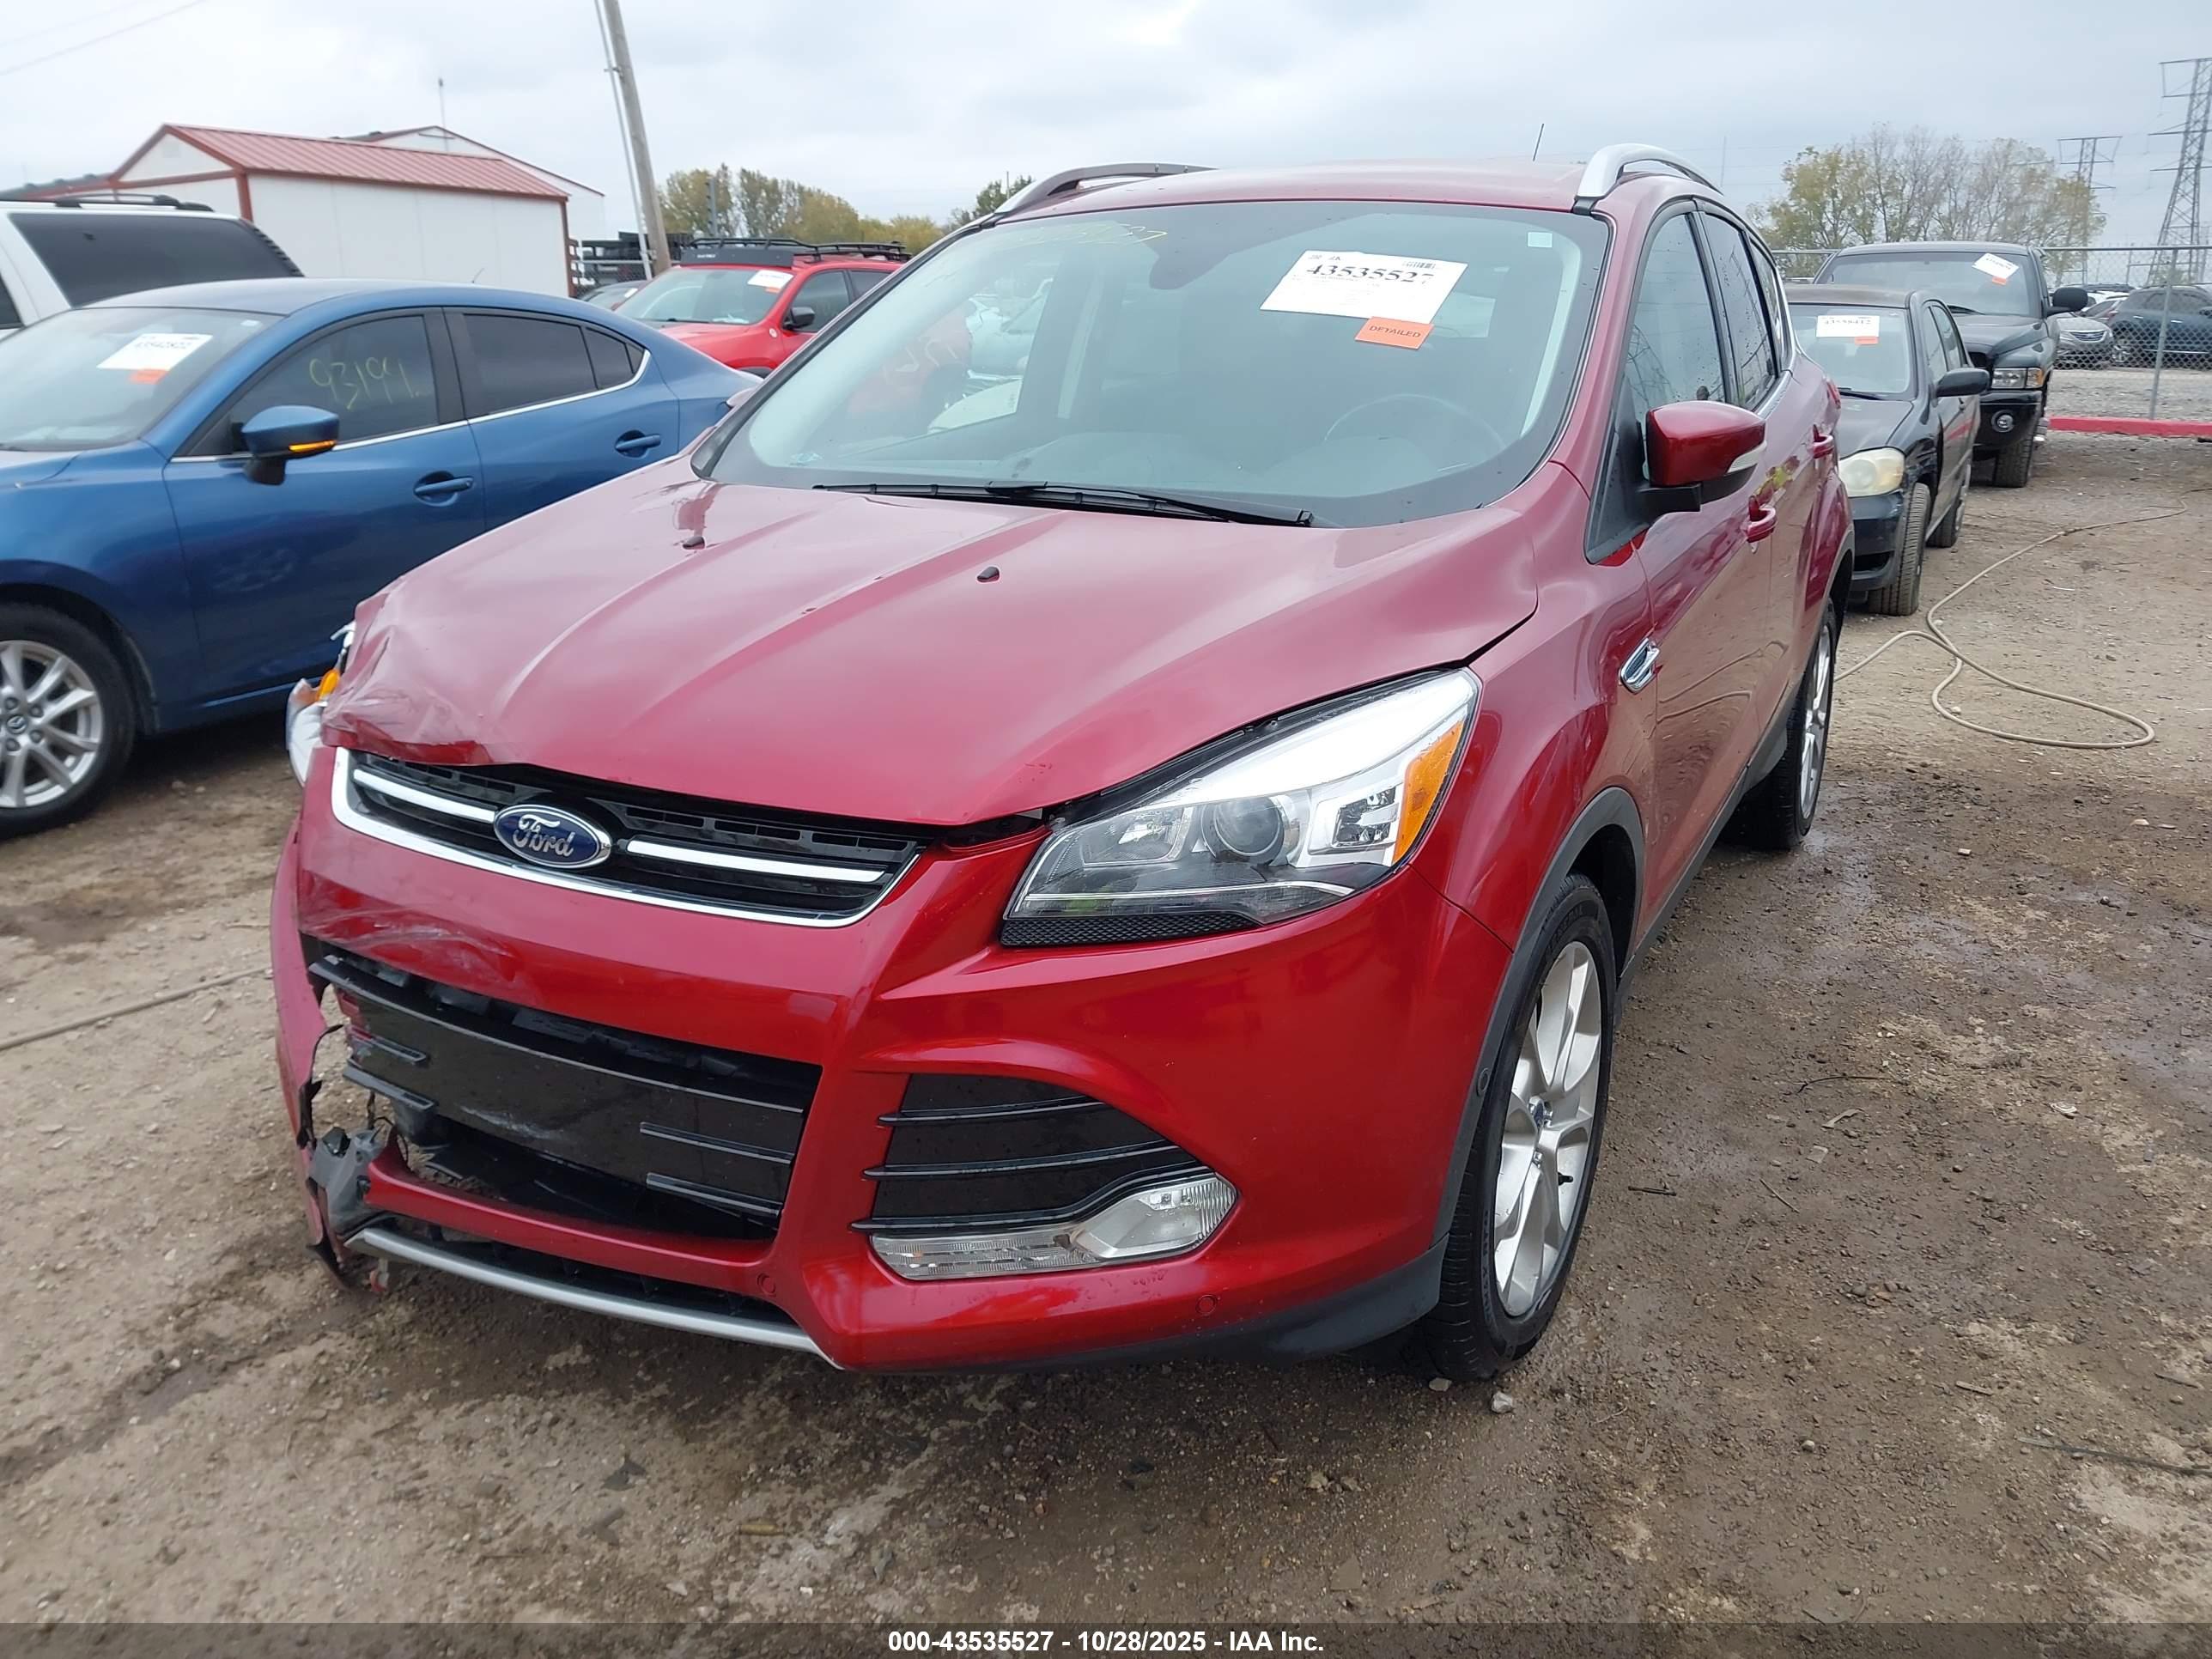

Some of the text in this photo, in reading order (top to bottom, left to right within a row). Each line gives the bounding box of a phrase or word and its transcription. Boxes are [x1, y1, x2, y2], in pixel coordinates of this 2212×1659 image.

[1306, 264, 1434, 284] 43535527
[1370, 325, 1421, 338] DETAILED
[513, 814, 576, 856] Ford
